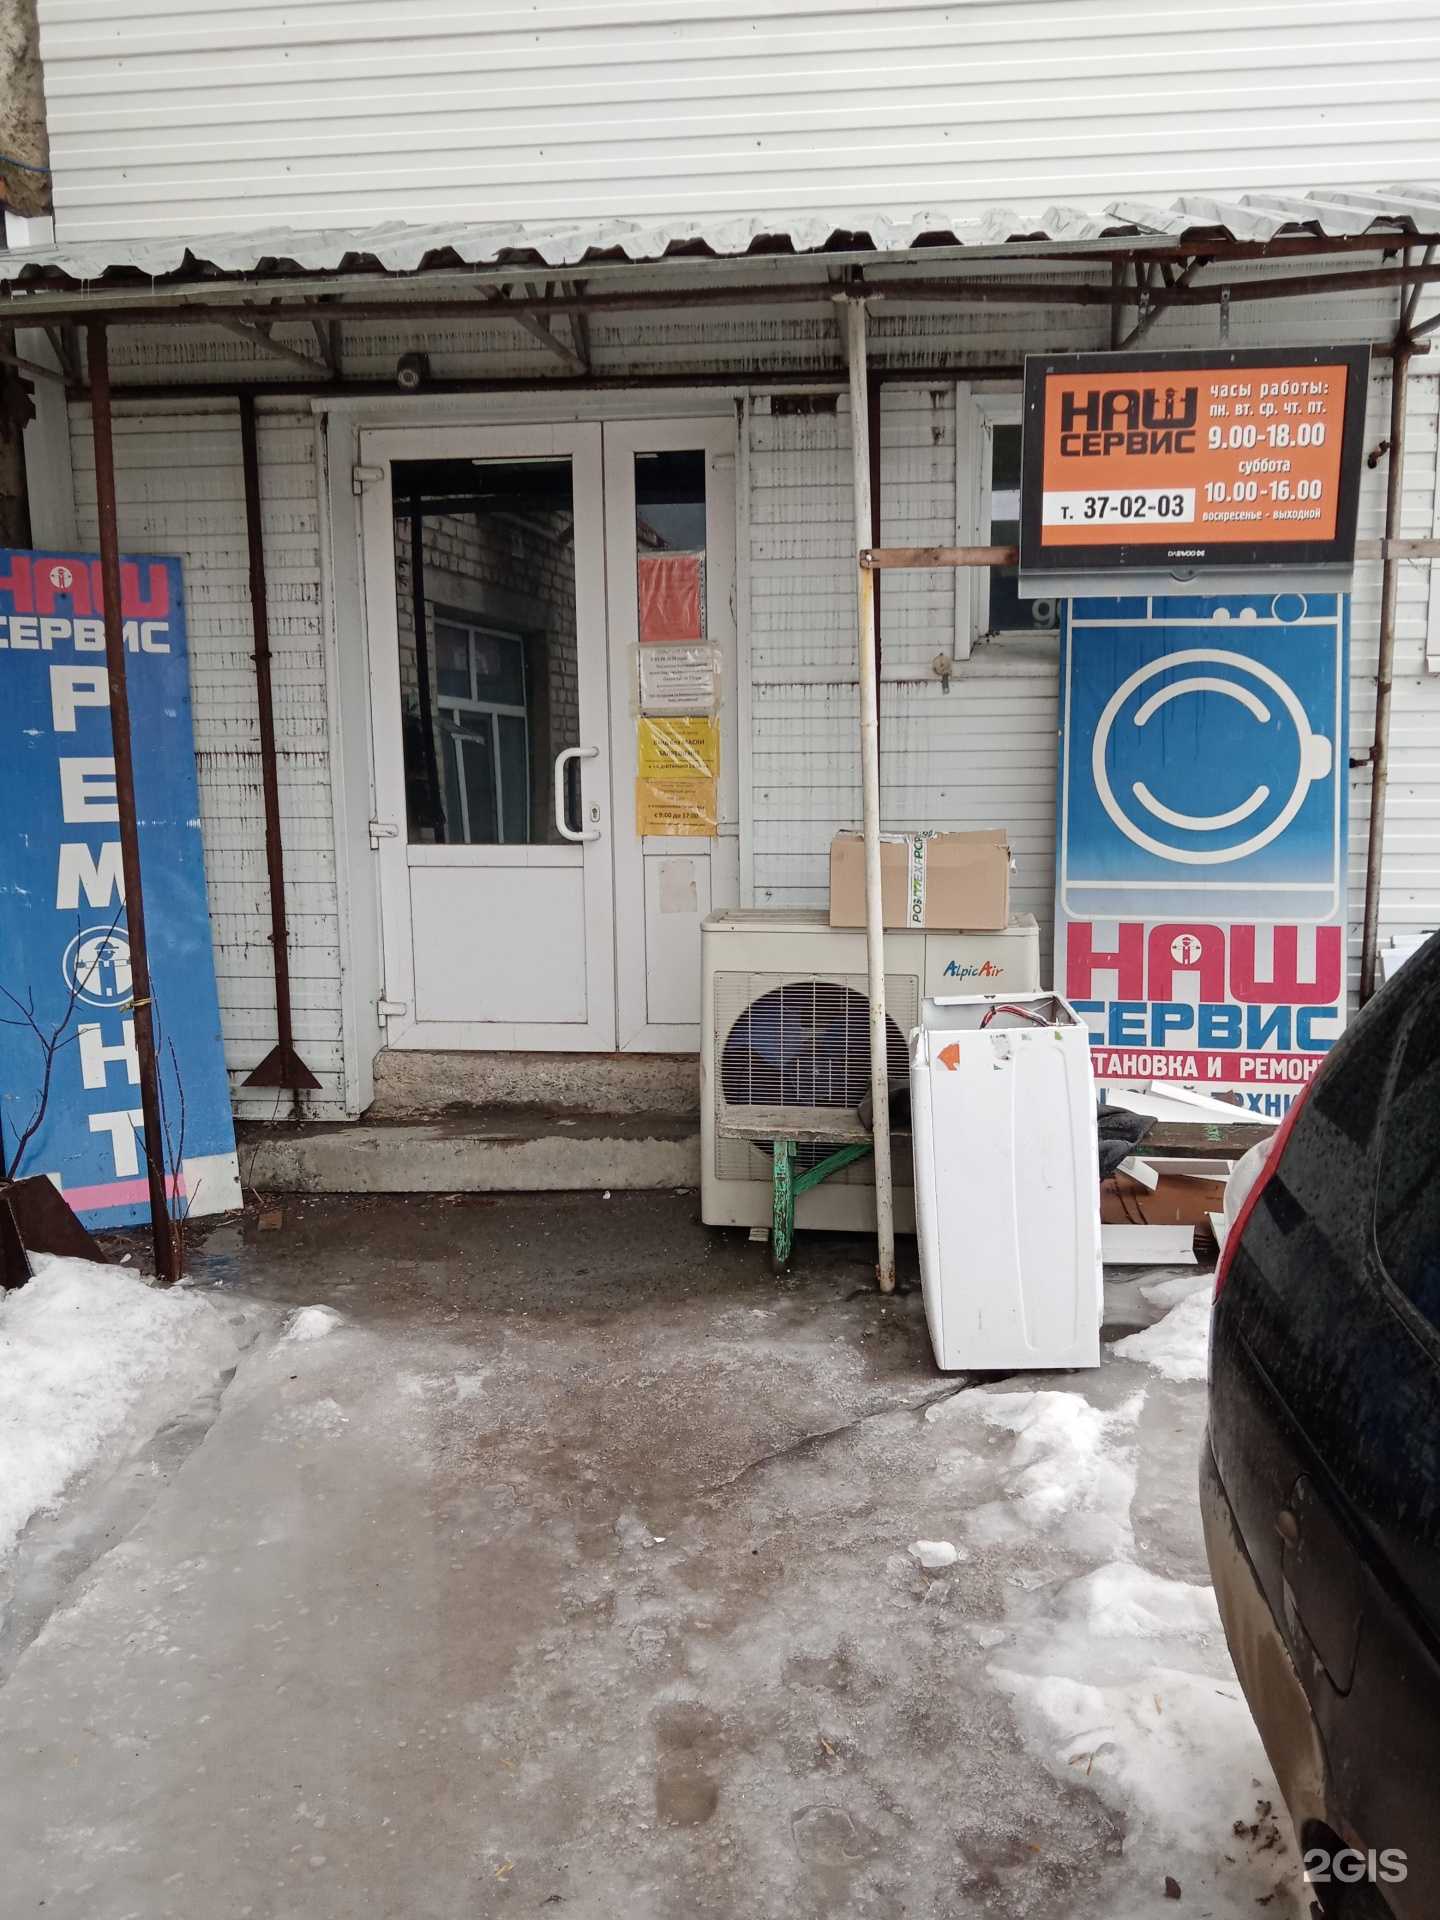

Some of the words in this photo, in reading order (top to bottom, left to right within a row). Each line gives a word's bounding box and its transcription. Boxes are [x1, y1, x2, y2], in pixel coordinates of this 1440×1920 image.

[1210, 384, 1252, 398] часы
[1260, 380, 1329, 399] работы:
[1061, 387, 1198, 432] НАШ
[1209, 404, 1230, 417] пн.
[1235, 404, 1254, 416] вт.
[1259, 402, 1278, 417] ср.
[1284, 401, 1302, 415] чт.
[1308, 401, 1326, 414] пт.
[1060, 430, 1196, 457] СЕРВИС
[1208, 422, 1326, 450] 9.00-18.00
[1238, 458, 1291, 476] суббота
[1204, 480, 1323, 502] 10.00-16.00
[1084, 495, 1184, 519] 37-02-03
[1202, 510, 1263, 522] воскресенье
[1273, 508, 1322, 520] выходной
[943, 960, 1004, 981] AlpicAir
[1066, 922, 1341, 1005] НАШ
[1091, 1052, 1199, 1078] ТАНОВКА
[1207, 1056, 1222, 1078] И
[1240, 1057, 1323, 1081] РЕМОН
